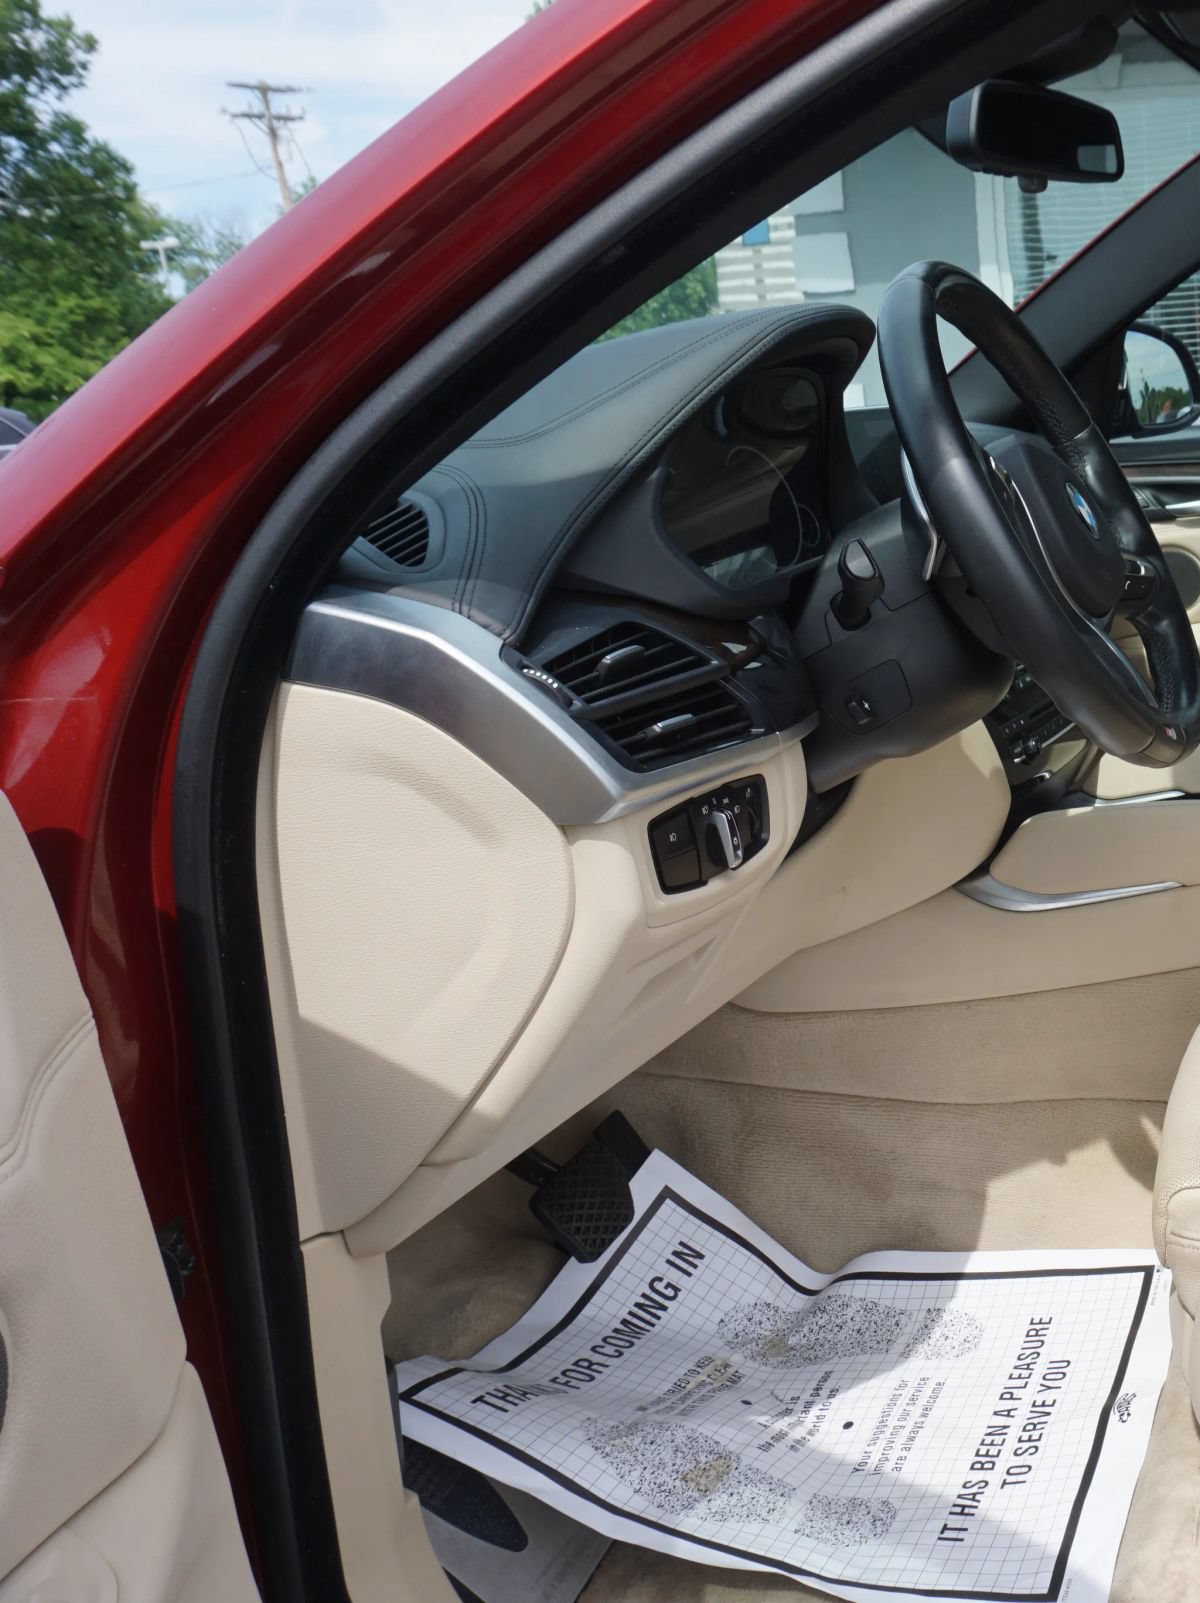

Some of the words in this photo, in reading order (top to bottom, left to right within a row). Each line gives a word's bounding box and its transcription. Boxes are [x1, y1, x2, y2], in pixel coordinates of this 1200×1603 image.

[549, 1358, 610, 1390] FOR
[590, 1276, 682, 1358] COMING
[665, 1240, 706, 1278] IN
[998, 1316, 1053, 1401] PLEASURE
[663, 1378, 690, 1399] TRIED
[683, 1369, 701, 1379] TO
[726, 1370, 747, 1386] MAT
[810, 1370, 834, 1398] person
[1037, 1360, 1071, 1394] YOU
[785, 1396, 800, 1404] is
[818, 1401, 832, 1411] to
[992, 1407, 1018, 1418] A
[851, 1450, 872, 1474] Your
[867, 1393, 902, 1448] suggestions
[894, 1380, 909, 1391] for
[869, 1425, 906, 1476] improving
[897, 1409, 910, 1422] our
[906, 1377, 929, 1407] service
[1013, 1399, 1056, 1456] SERVE
[891, 1455, 907, 1472] are
[900, 1420, 924, 1451] always
[969, 1425, 1011, 1471] BEEN
[1000, 1464, 1033, 1489] TO
[949, 1479, 989, 1517] HAS
[937, 1523, 969, 1542] IT
